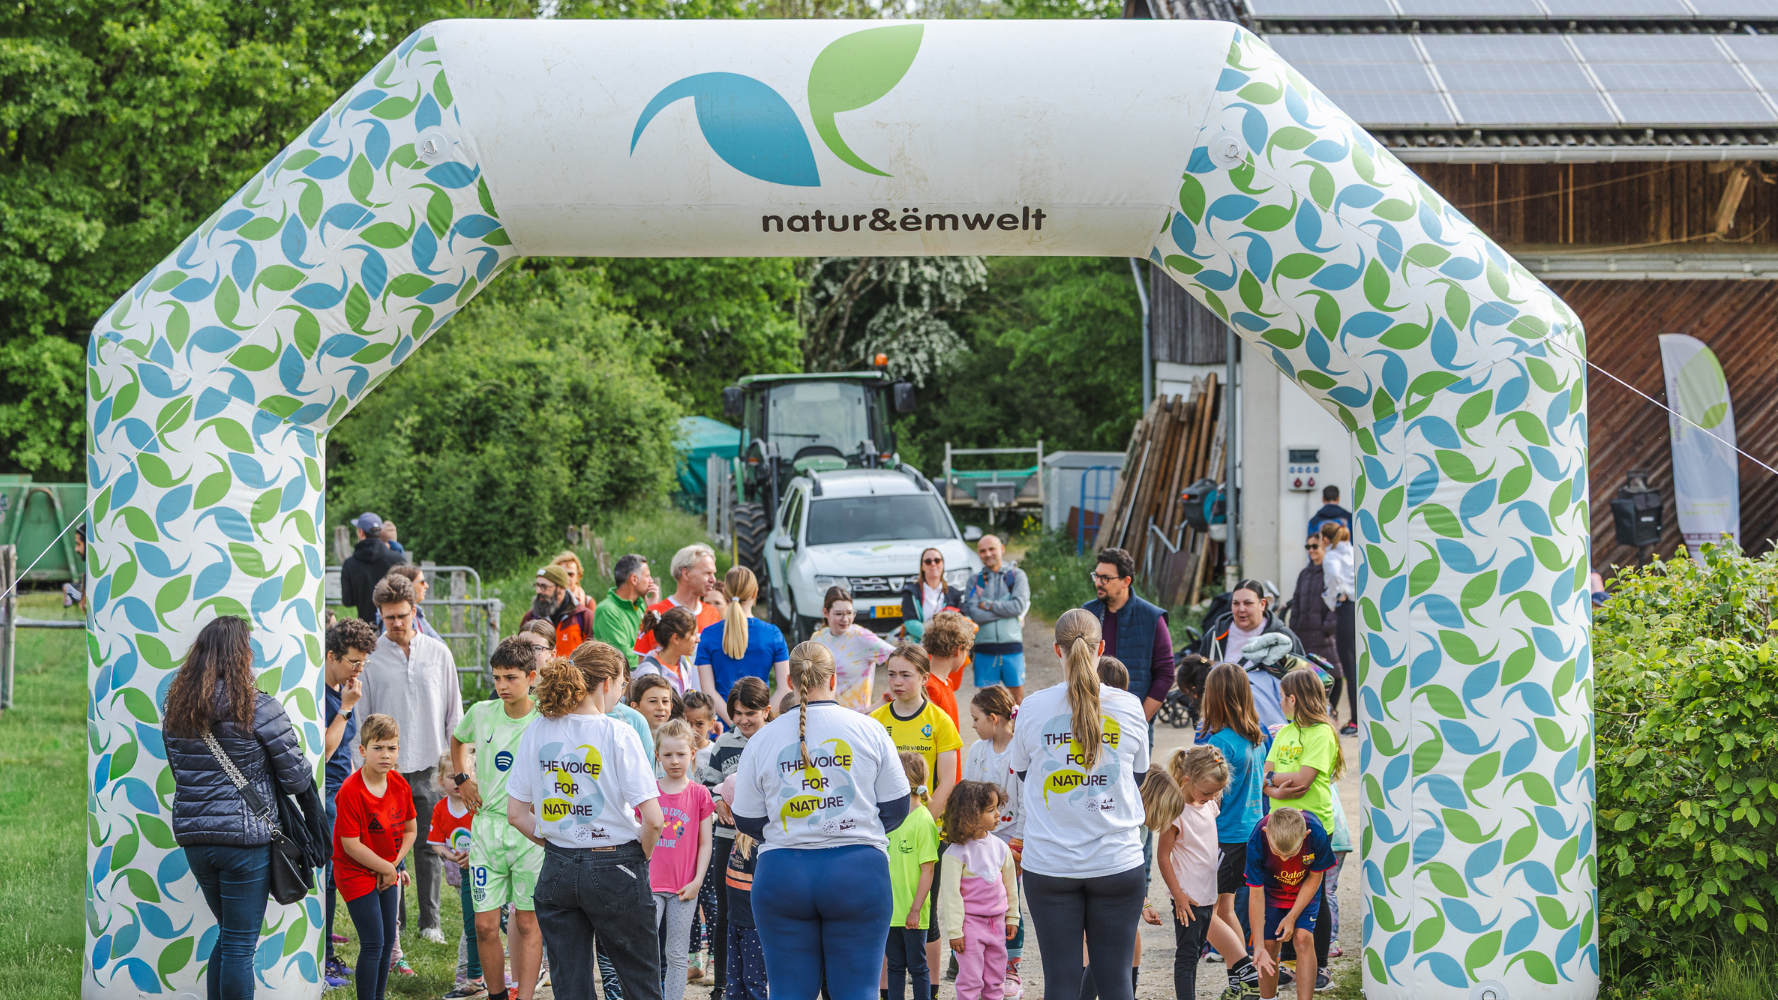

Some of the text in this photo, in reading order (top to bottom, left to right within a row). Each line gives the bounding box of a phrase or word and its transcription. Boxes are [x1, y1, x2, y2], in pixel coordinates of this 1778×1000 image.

[762, 205, 1047, 233] natur&ëmwelt
[1043, 732, 1072, 745] THE
[539, 760, 601, 775] THE VOICE
[780, 754, 852, 773] THE VOICE
[802, 777, 829, 791] FOR
[1052, 774, 1108, 787] NATURE
[554, 782, 579, 795] FOR
[543, 803, 593, 817] NATURE
[789, 795, 845, 813] NATURE
[471, 866, 487, 887] 19
